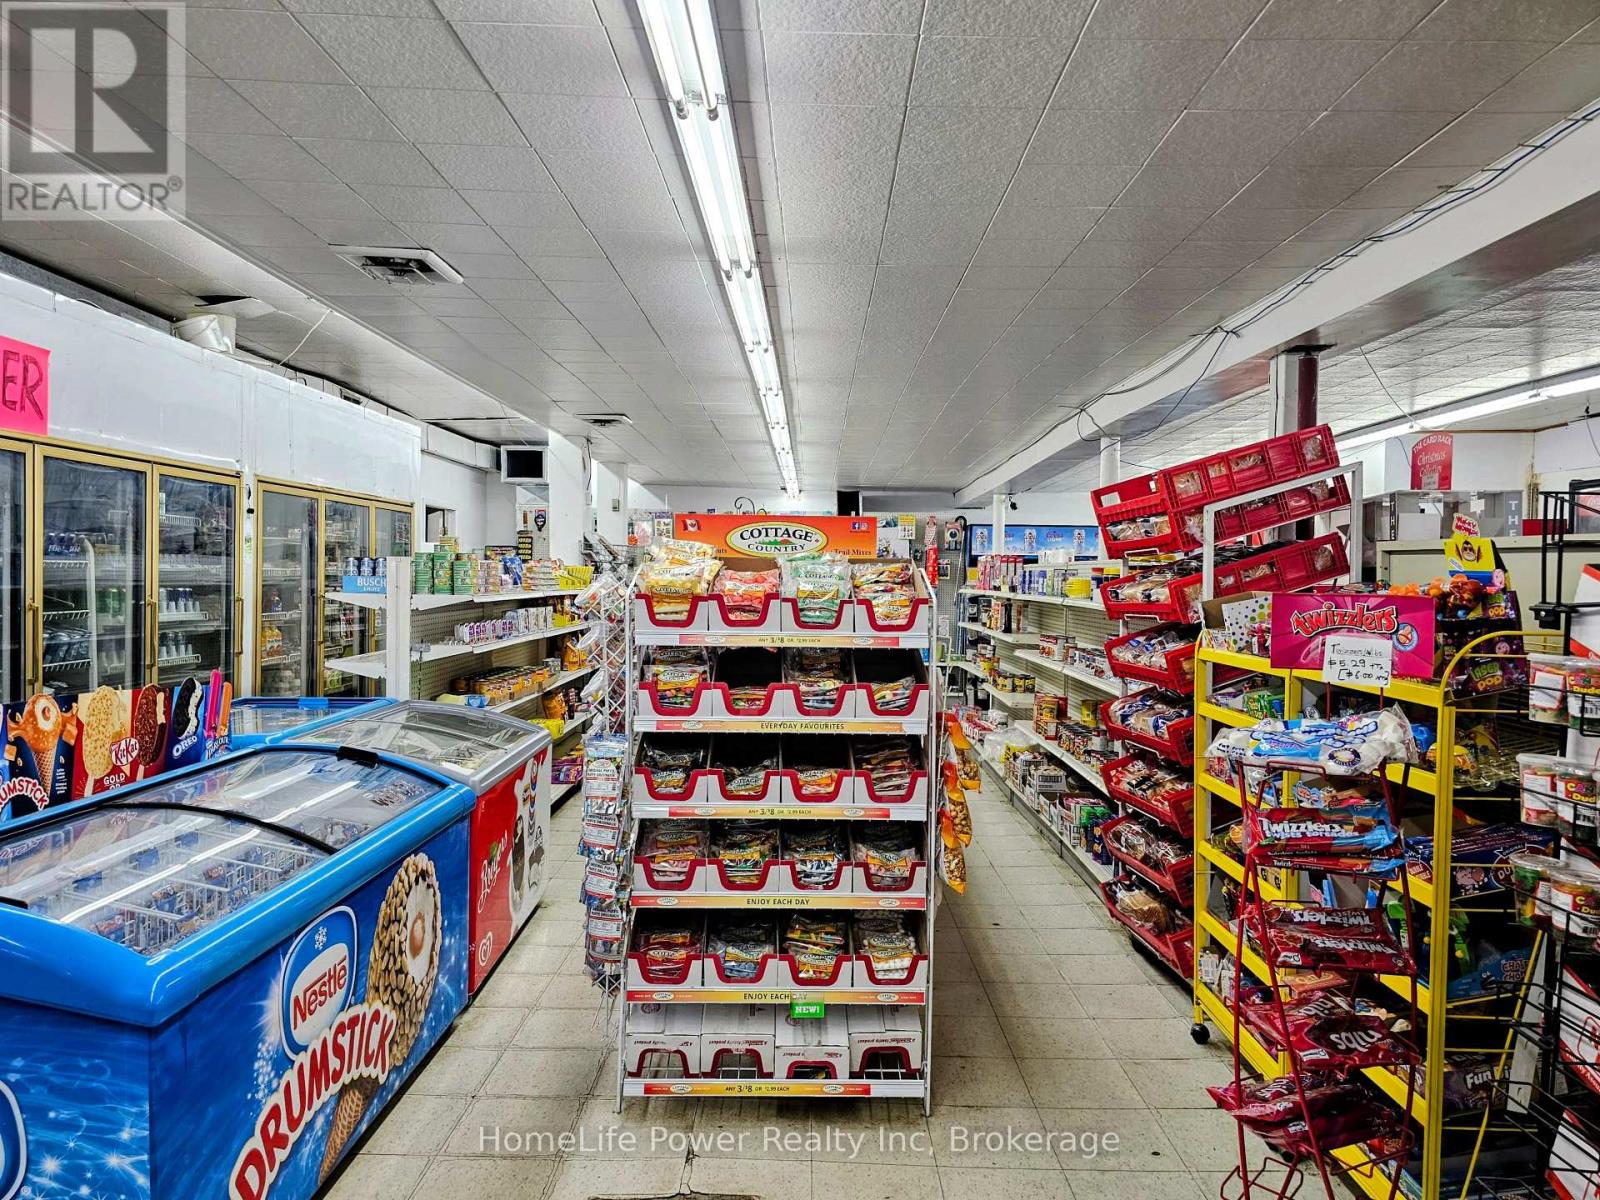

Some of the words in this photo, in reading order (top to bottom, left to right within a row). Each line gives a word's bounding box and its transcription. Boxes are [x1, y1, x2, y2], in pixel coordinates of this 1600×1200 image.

[1423, 436, 1437, 447] CARD
[1437, 435, 1453, 446] RACK
[740, 527, 813, 542] COTTAGE
[748, 543, 806, 553] COUNTRY
[173, 736, 198, 757] OREO
[103, 774, 126, 785] GOLD
[294, 955, 348, 1030] Nestlé
[743, 992, 768, 1000] ENJOY
[770, 992, 790, 1000] EACH
[795, 1005, 820, 1014] NEW!
[1330, 1029, 1382, 1052] nibs
[1466, 1070, 1492, 1090] Fun
[235, 1008, 395, 1200] DRUMSTICK
